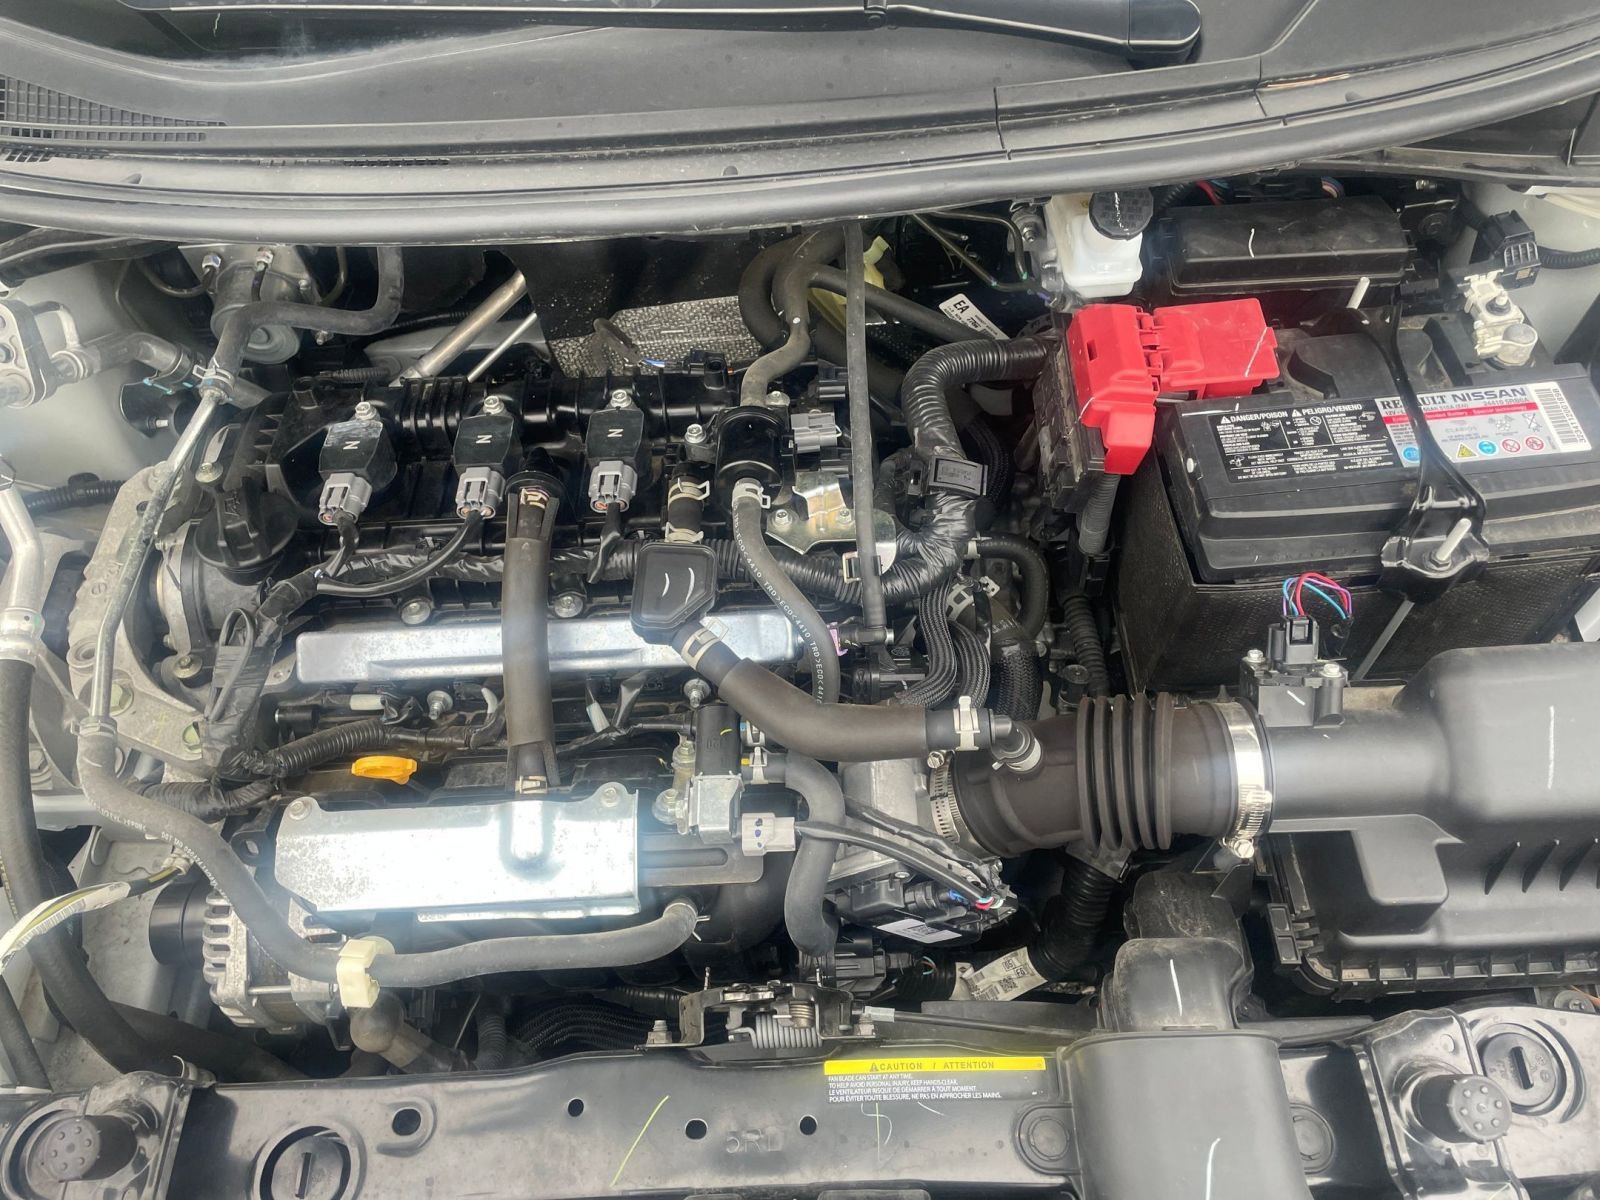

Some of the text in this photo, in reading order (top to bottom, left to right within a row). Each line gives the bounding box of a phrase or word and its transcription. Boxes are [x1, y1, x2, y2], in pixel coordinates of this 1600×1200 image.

[953, 300, 970, 314] EA
[1452, 387, 1527, 402] NISSAN
[1230, 404, 1363, 422] DANGER/POISON PELIGRO/VENENO
[880, 1062, 922, 1071] CAUTION
[943, 1061, 995, 1070] ATTENTION
